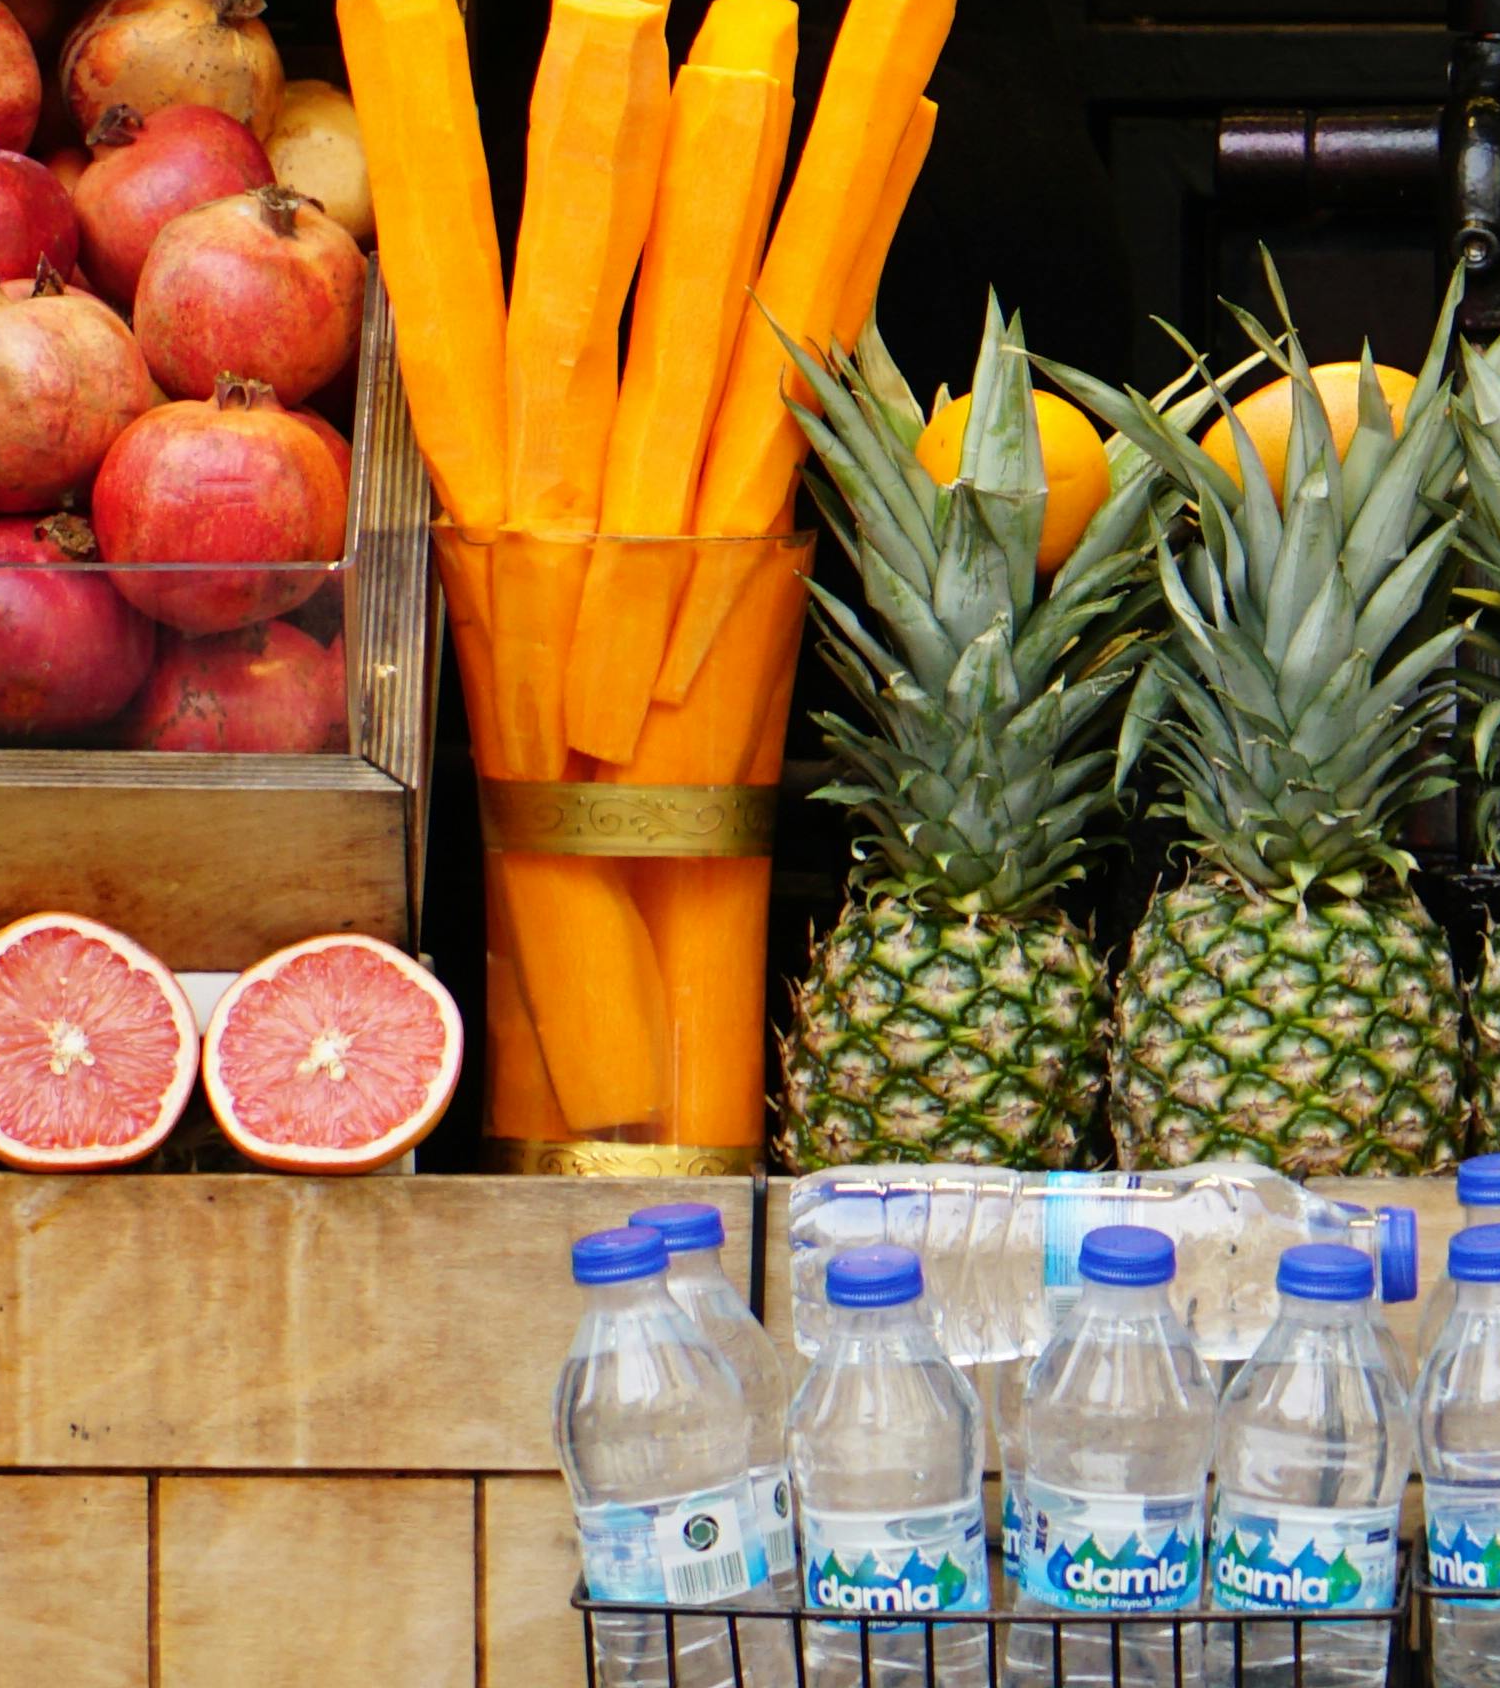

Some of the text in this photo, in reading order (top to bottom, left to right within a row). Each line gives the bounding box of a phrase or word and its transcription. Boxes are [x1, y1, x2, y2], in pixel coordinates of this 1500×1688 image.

[1065, 1557, 1188, 1594] damla
[1218, 1552, 1330, 1604] damla
[1429, 1551, 1487, 1588] mla
[818, 1573, 940, 1612] damla
